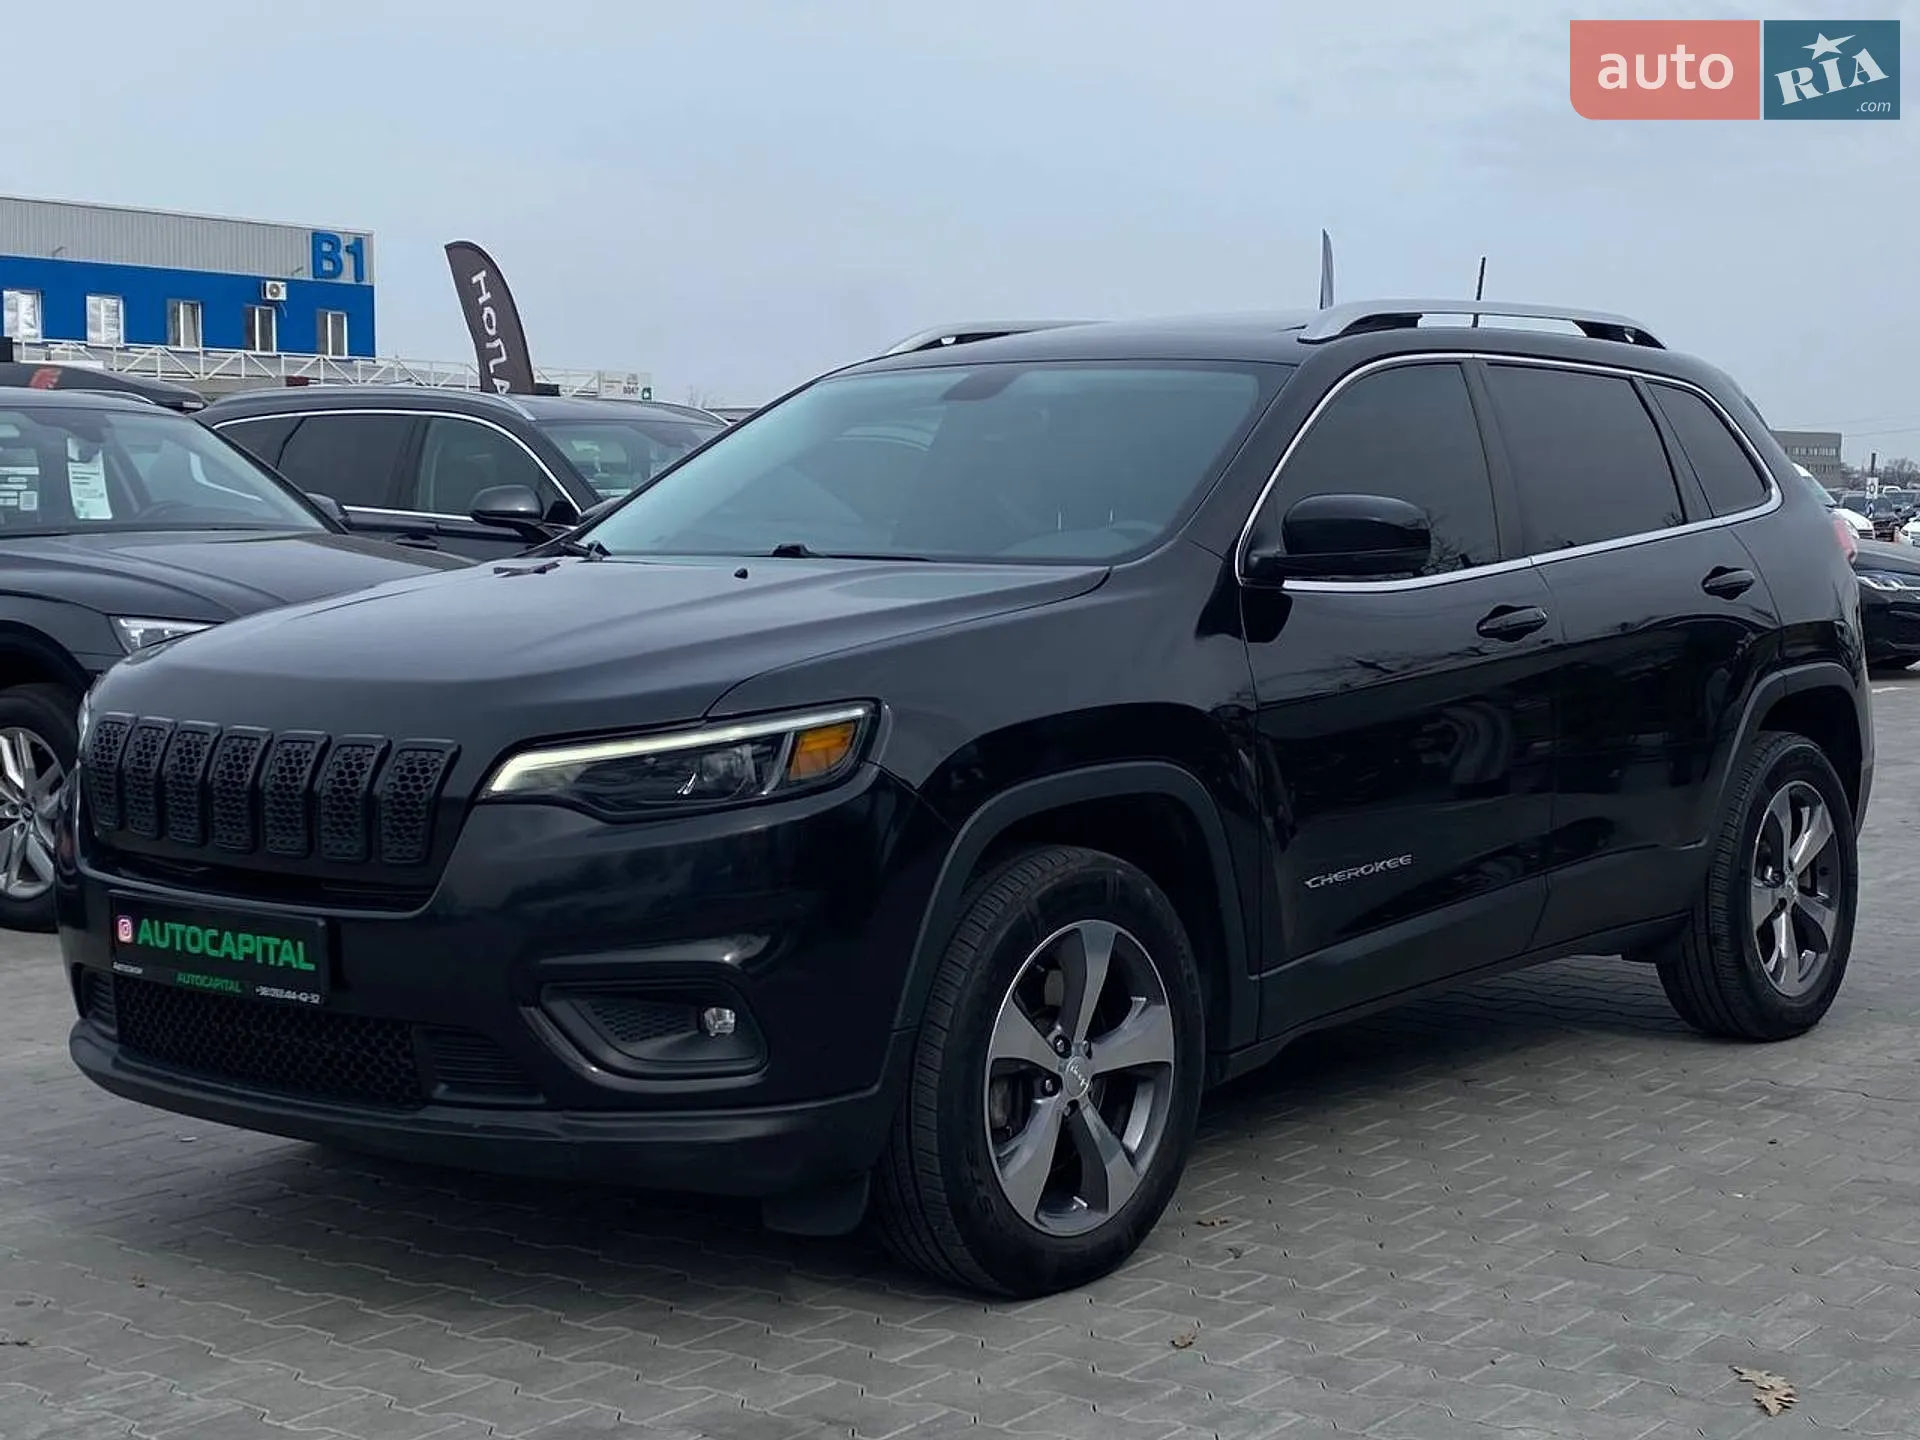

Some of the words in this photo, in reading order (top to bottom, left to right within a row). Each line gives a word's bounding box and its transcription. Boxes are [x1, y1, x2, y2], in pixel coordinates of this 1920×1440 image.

[311, 231, 365, 283] B1
[1304, 854, 1412, 888] CHEROKEE
[137, 918, 316, 971] AUTOCAPITAL
[176, 971, 242, 993] AUTOCAPITAL
